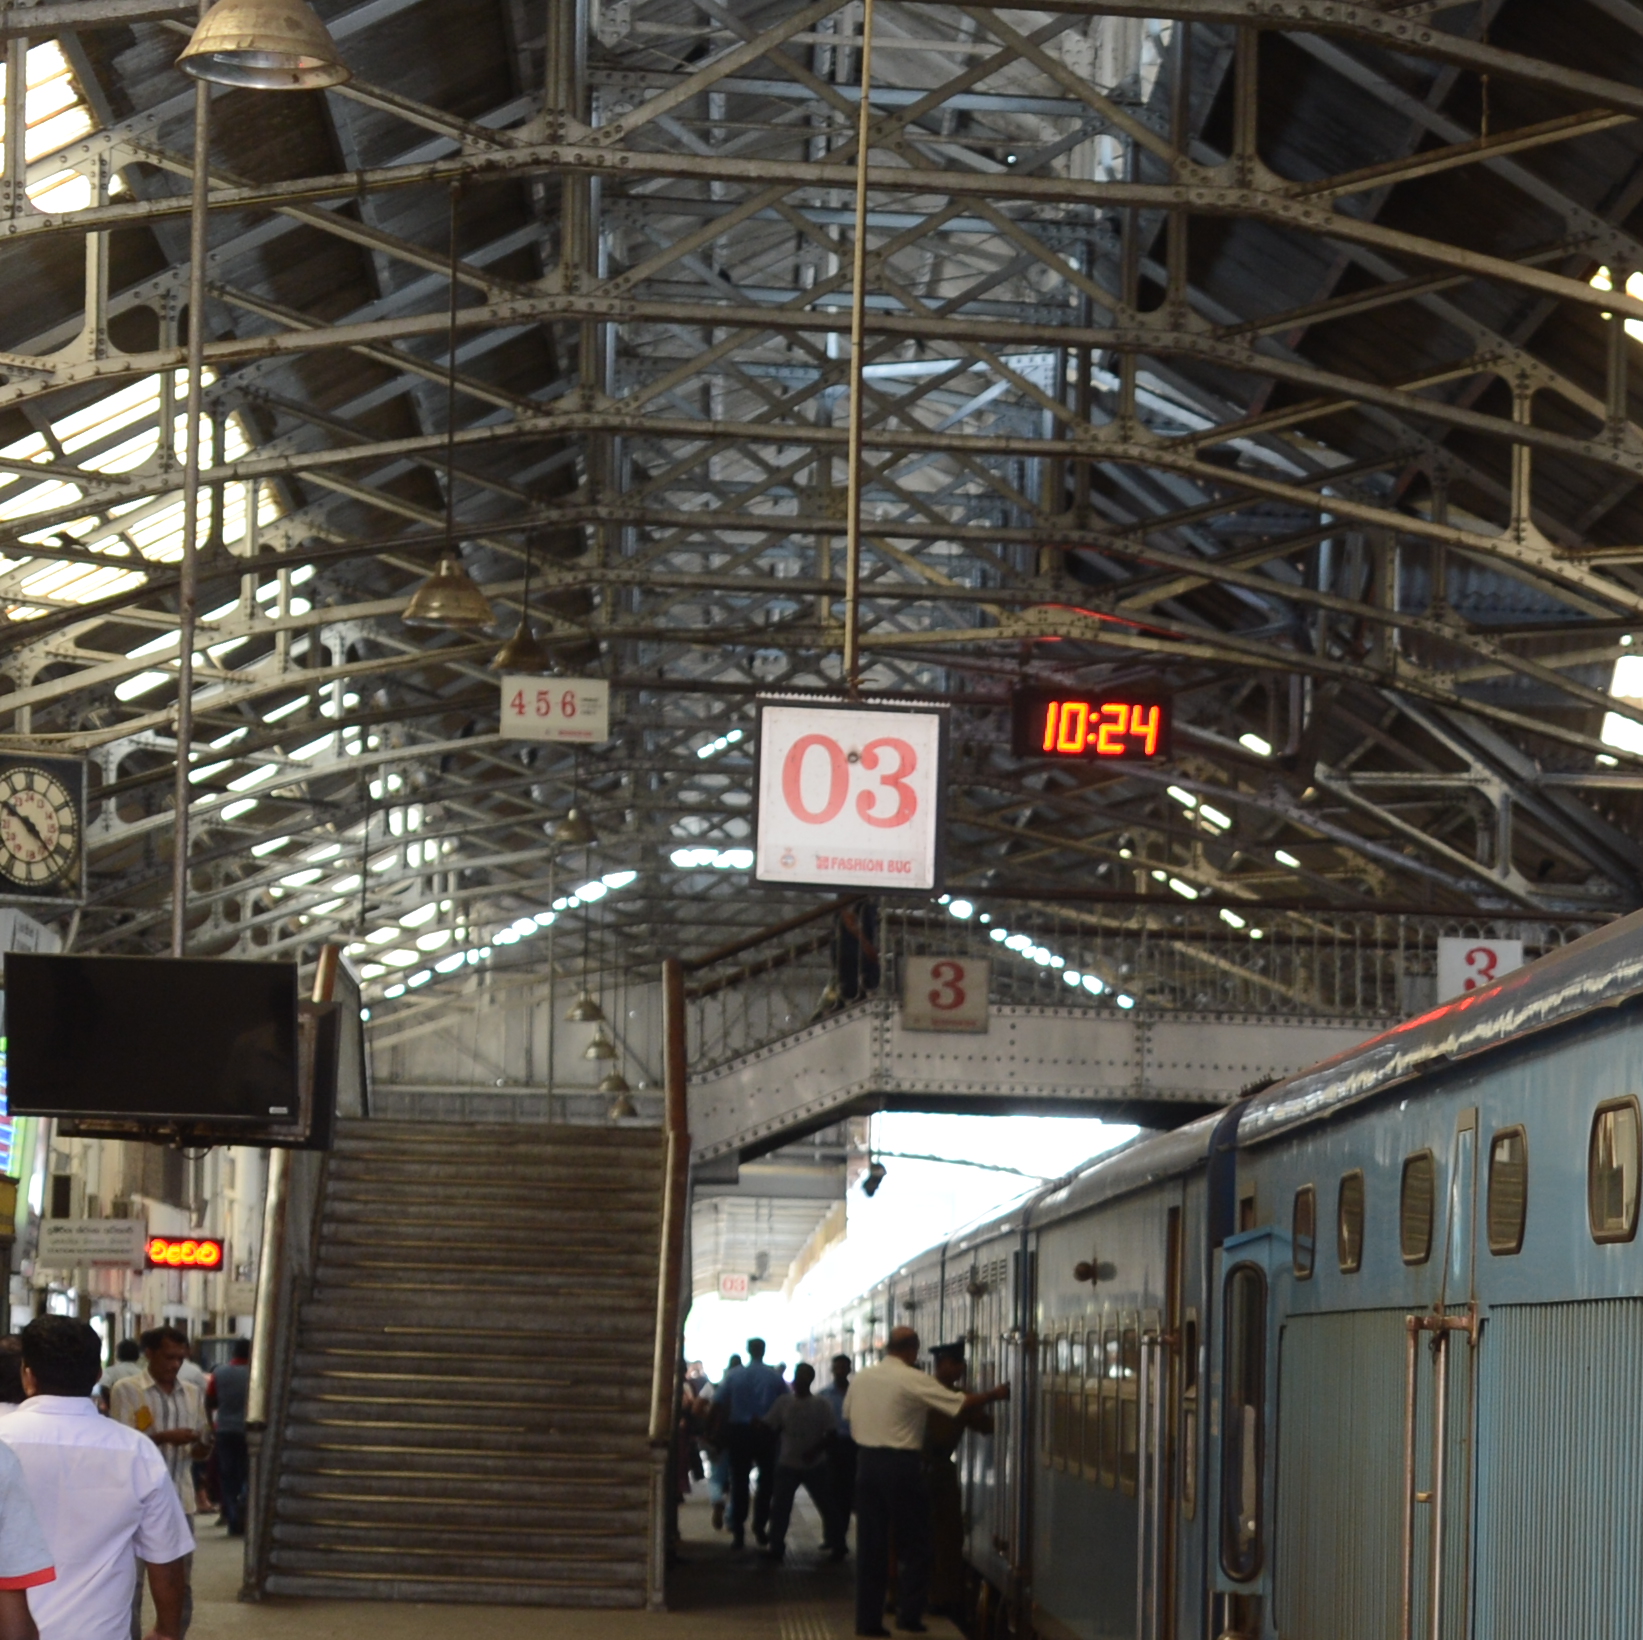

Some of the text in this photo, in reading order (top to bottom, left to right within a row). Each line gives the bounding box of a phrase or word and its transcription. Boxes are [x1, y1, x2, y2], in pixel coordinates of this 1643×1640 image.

[510, 688, 526, 716] 4
[536, 689, 551, 718] 5
[561, 689, 577, 718] 6
[1043, 701, 1161, 756] 10:24
[782, 733, 918, 829] 03
[830, 856, 912, 874] FASHION BUG
[928, 960, 966, 1011] 3
[1463, 946, 1498, 992] 3
